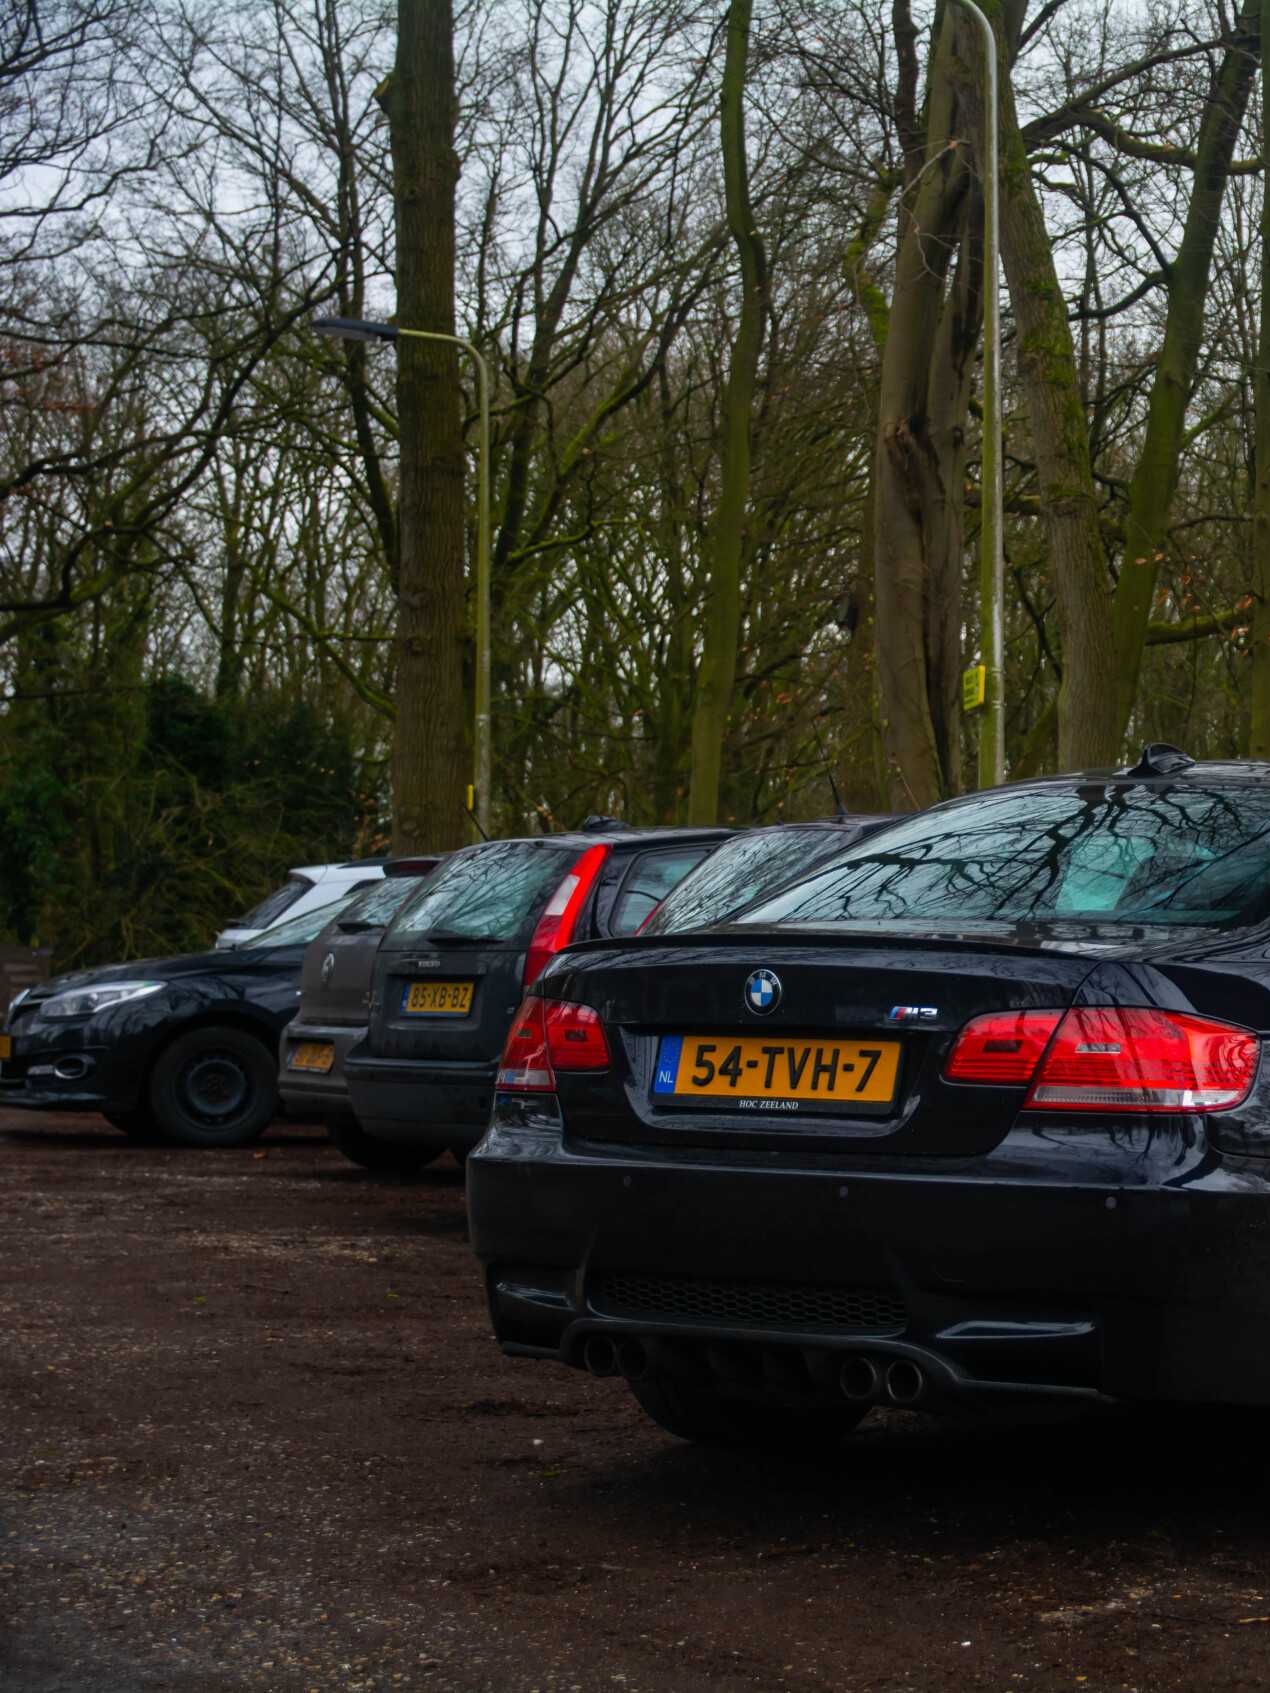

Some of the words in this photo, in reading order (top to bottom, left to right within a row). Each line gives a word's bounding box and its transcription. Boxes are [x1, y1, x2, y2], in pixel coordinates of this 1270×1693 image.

[748, 971, 779, 987] BMW
[411, 987, 469, 1008] 85-XB-BZ
[897, 1006, 938, 1020] M3
[659, 1070, 674, 1084] NL
[692, 1044, 882, 1092] 54-TVH-7
[739, 1099, 757, 1108] HOC
[759, 1100, 799, 1110] ZEELAND
